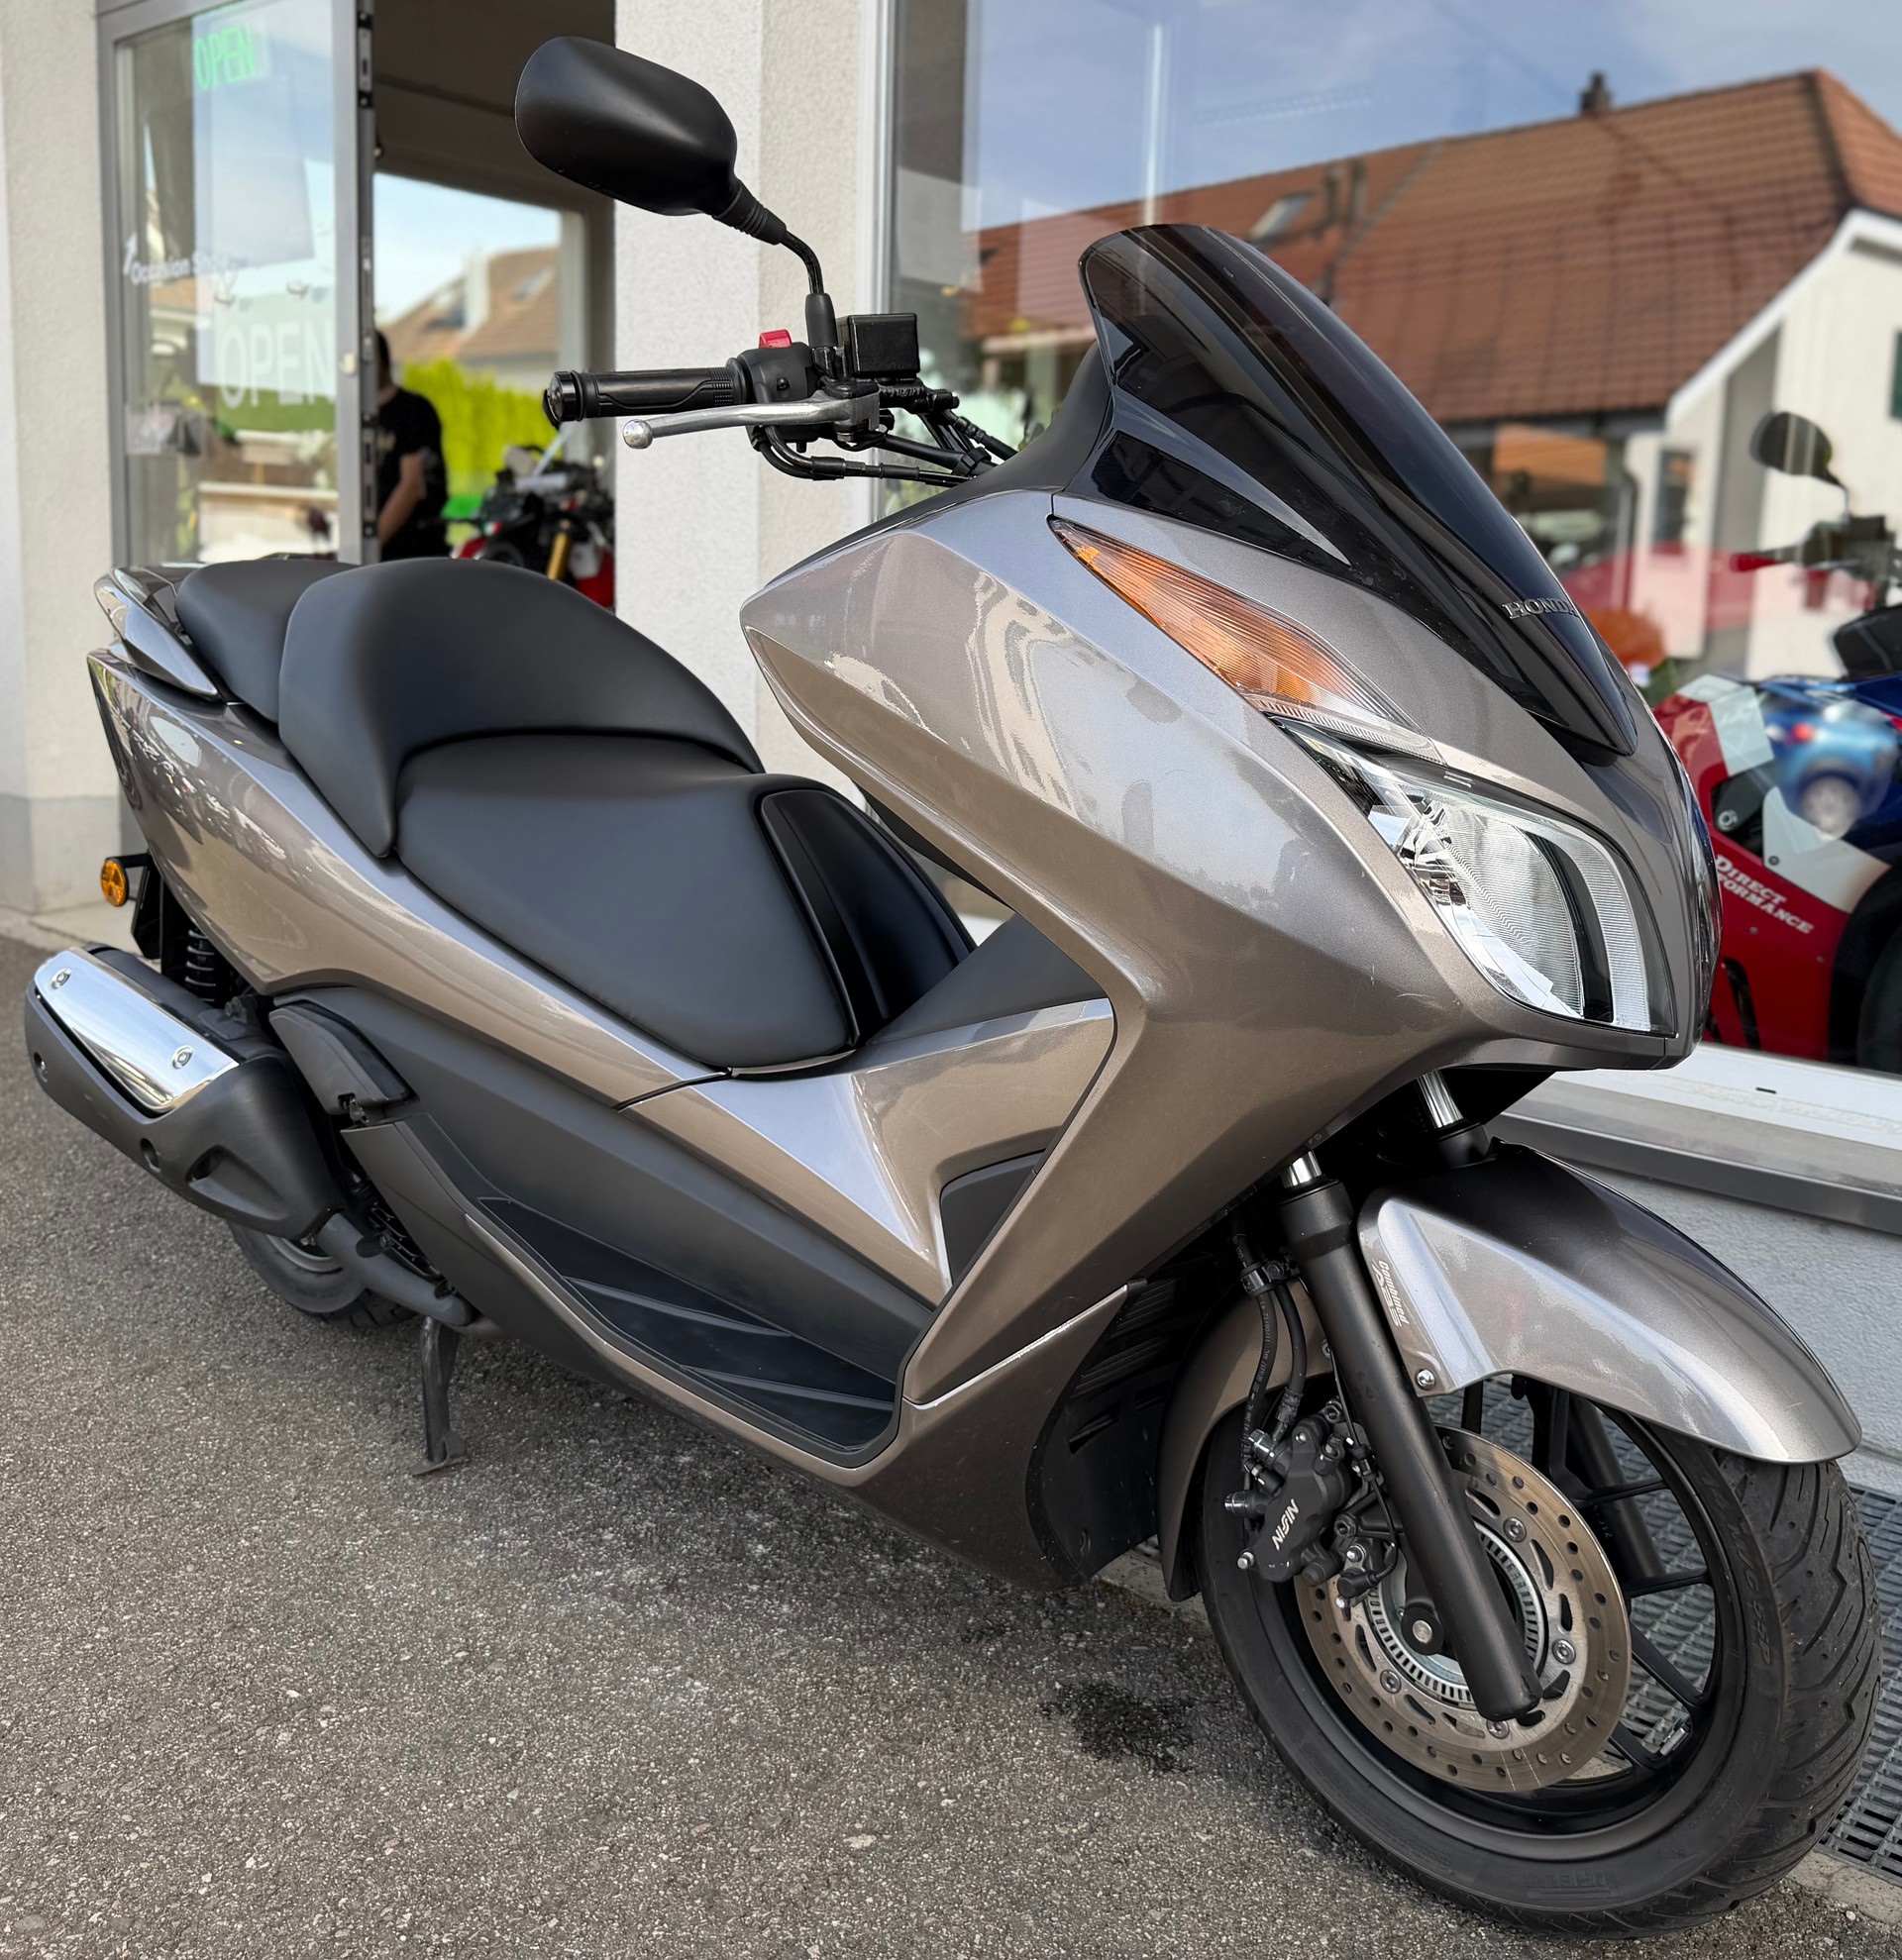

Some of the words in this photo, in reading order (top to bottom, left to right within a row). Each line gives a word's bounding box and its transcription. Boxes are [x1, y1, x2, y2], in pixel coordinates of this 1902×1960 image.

[195, 27, 256, 91] OPEN
[217, 319, 336, 409] OPEN
[1502, 597, 1581, 619] HONDA
[1715, 854, 1787, 905] DIRECT
[1378, 1260, 1410, 1325] Combined
